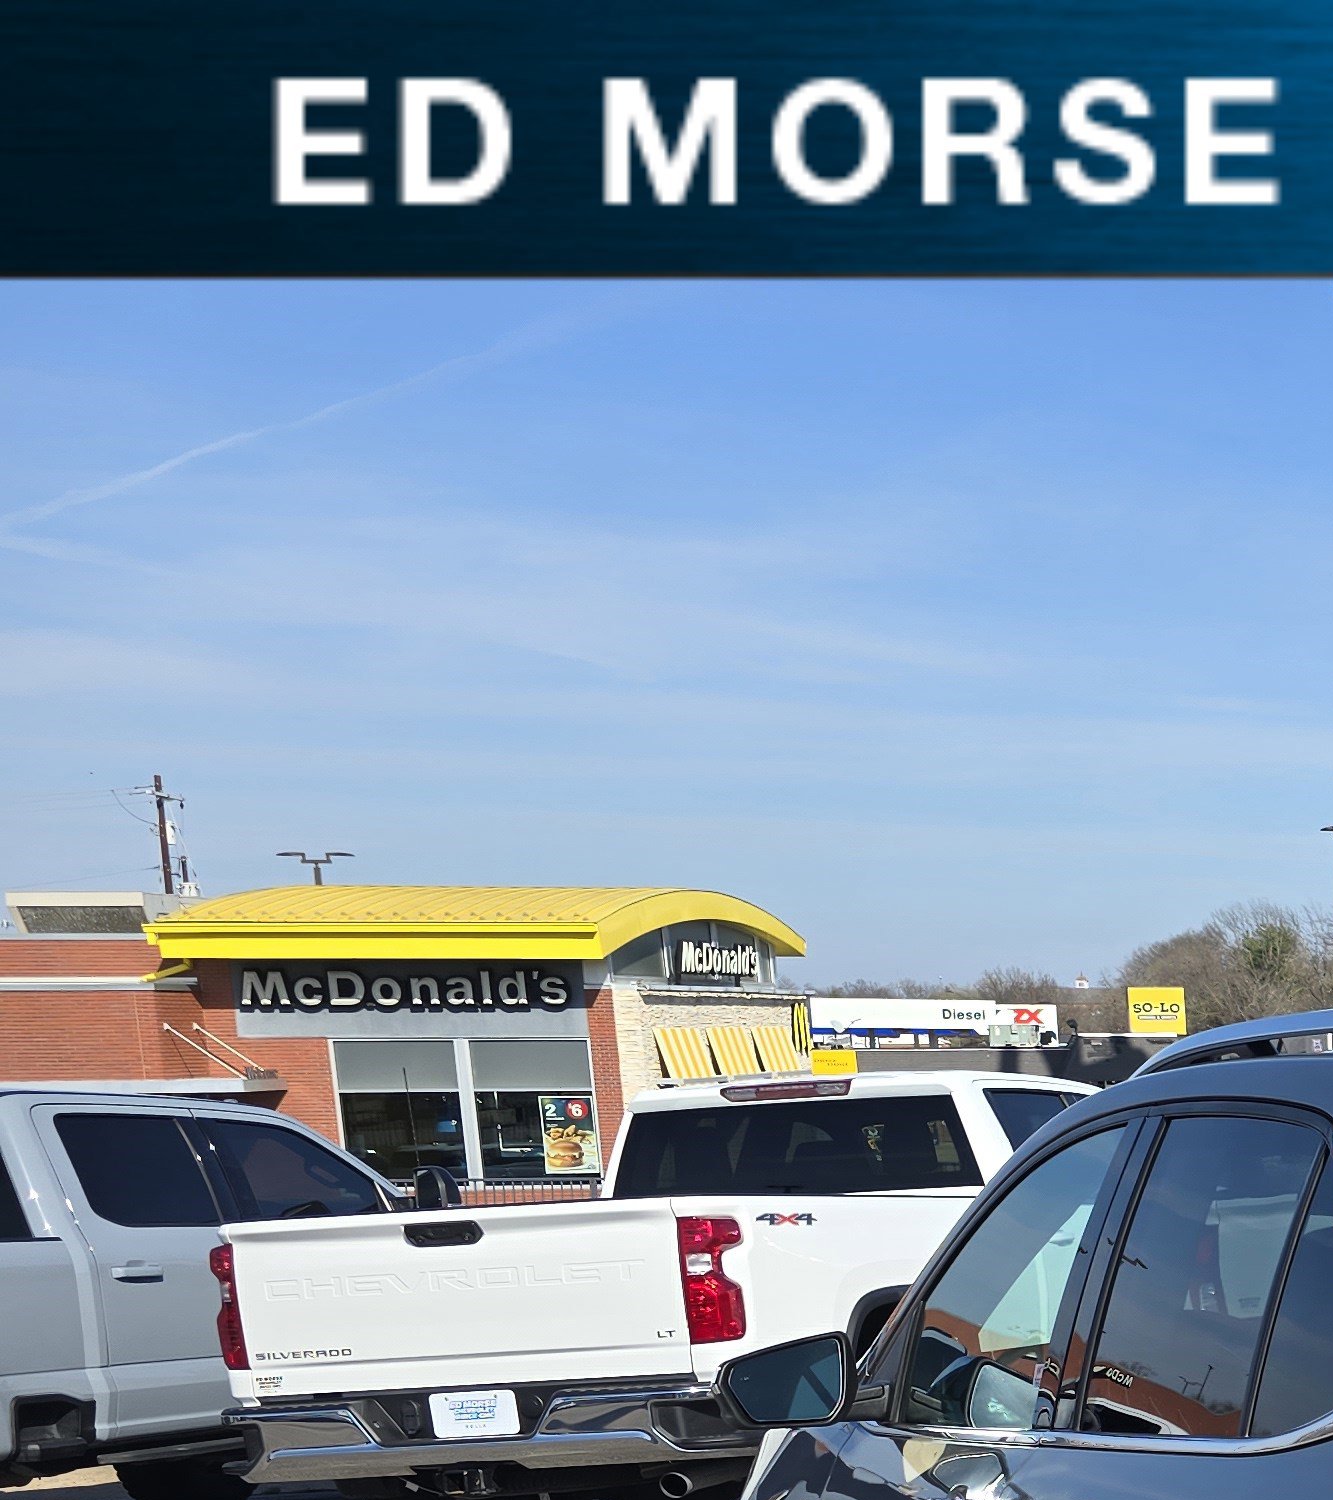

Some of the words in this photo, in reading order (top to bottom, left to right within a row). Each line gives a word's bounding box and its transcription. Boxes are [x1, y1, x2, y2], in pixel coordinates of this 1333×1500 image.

[681, 940, 760, 977] McDonald's
[240, 969, 569, 1010] McDonald's
[1132, 1002, 1180, 1013] SO-LO
[942, 1009, 986, 1020] Diesel
[544, 1103, 557, 1117] 2
[264, 1257, 648, 1301] CHEVROLET
[656, 1328, 677, 1339] LT
[255, 1348, 352, 1361] SILVERADO
